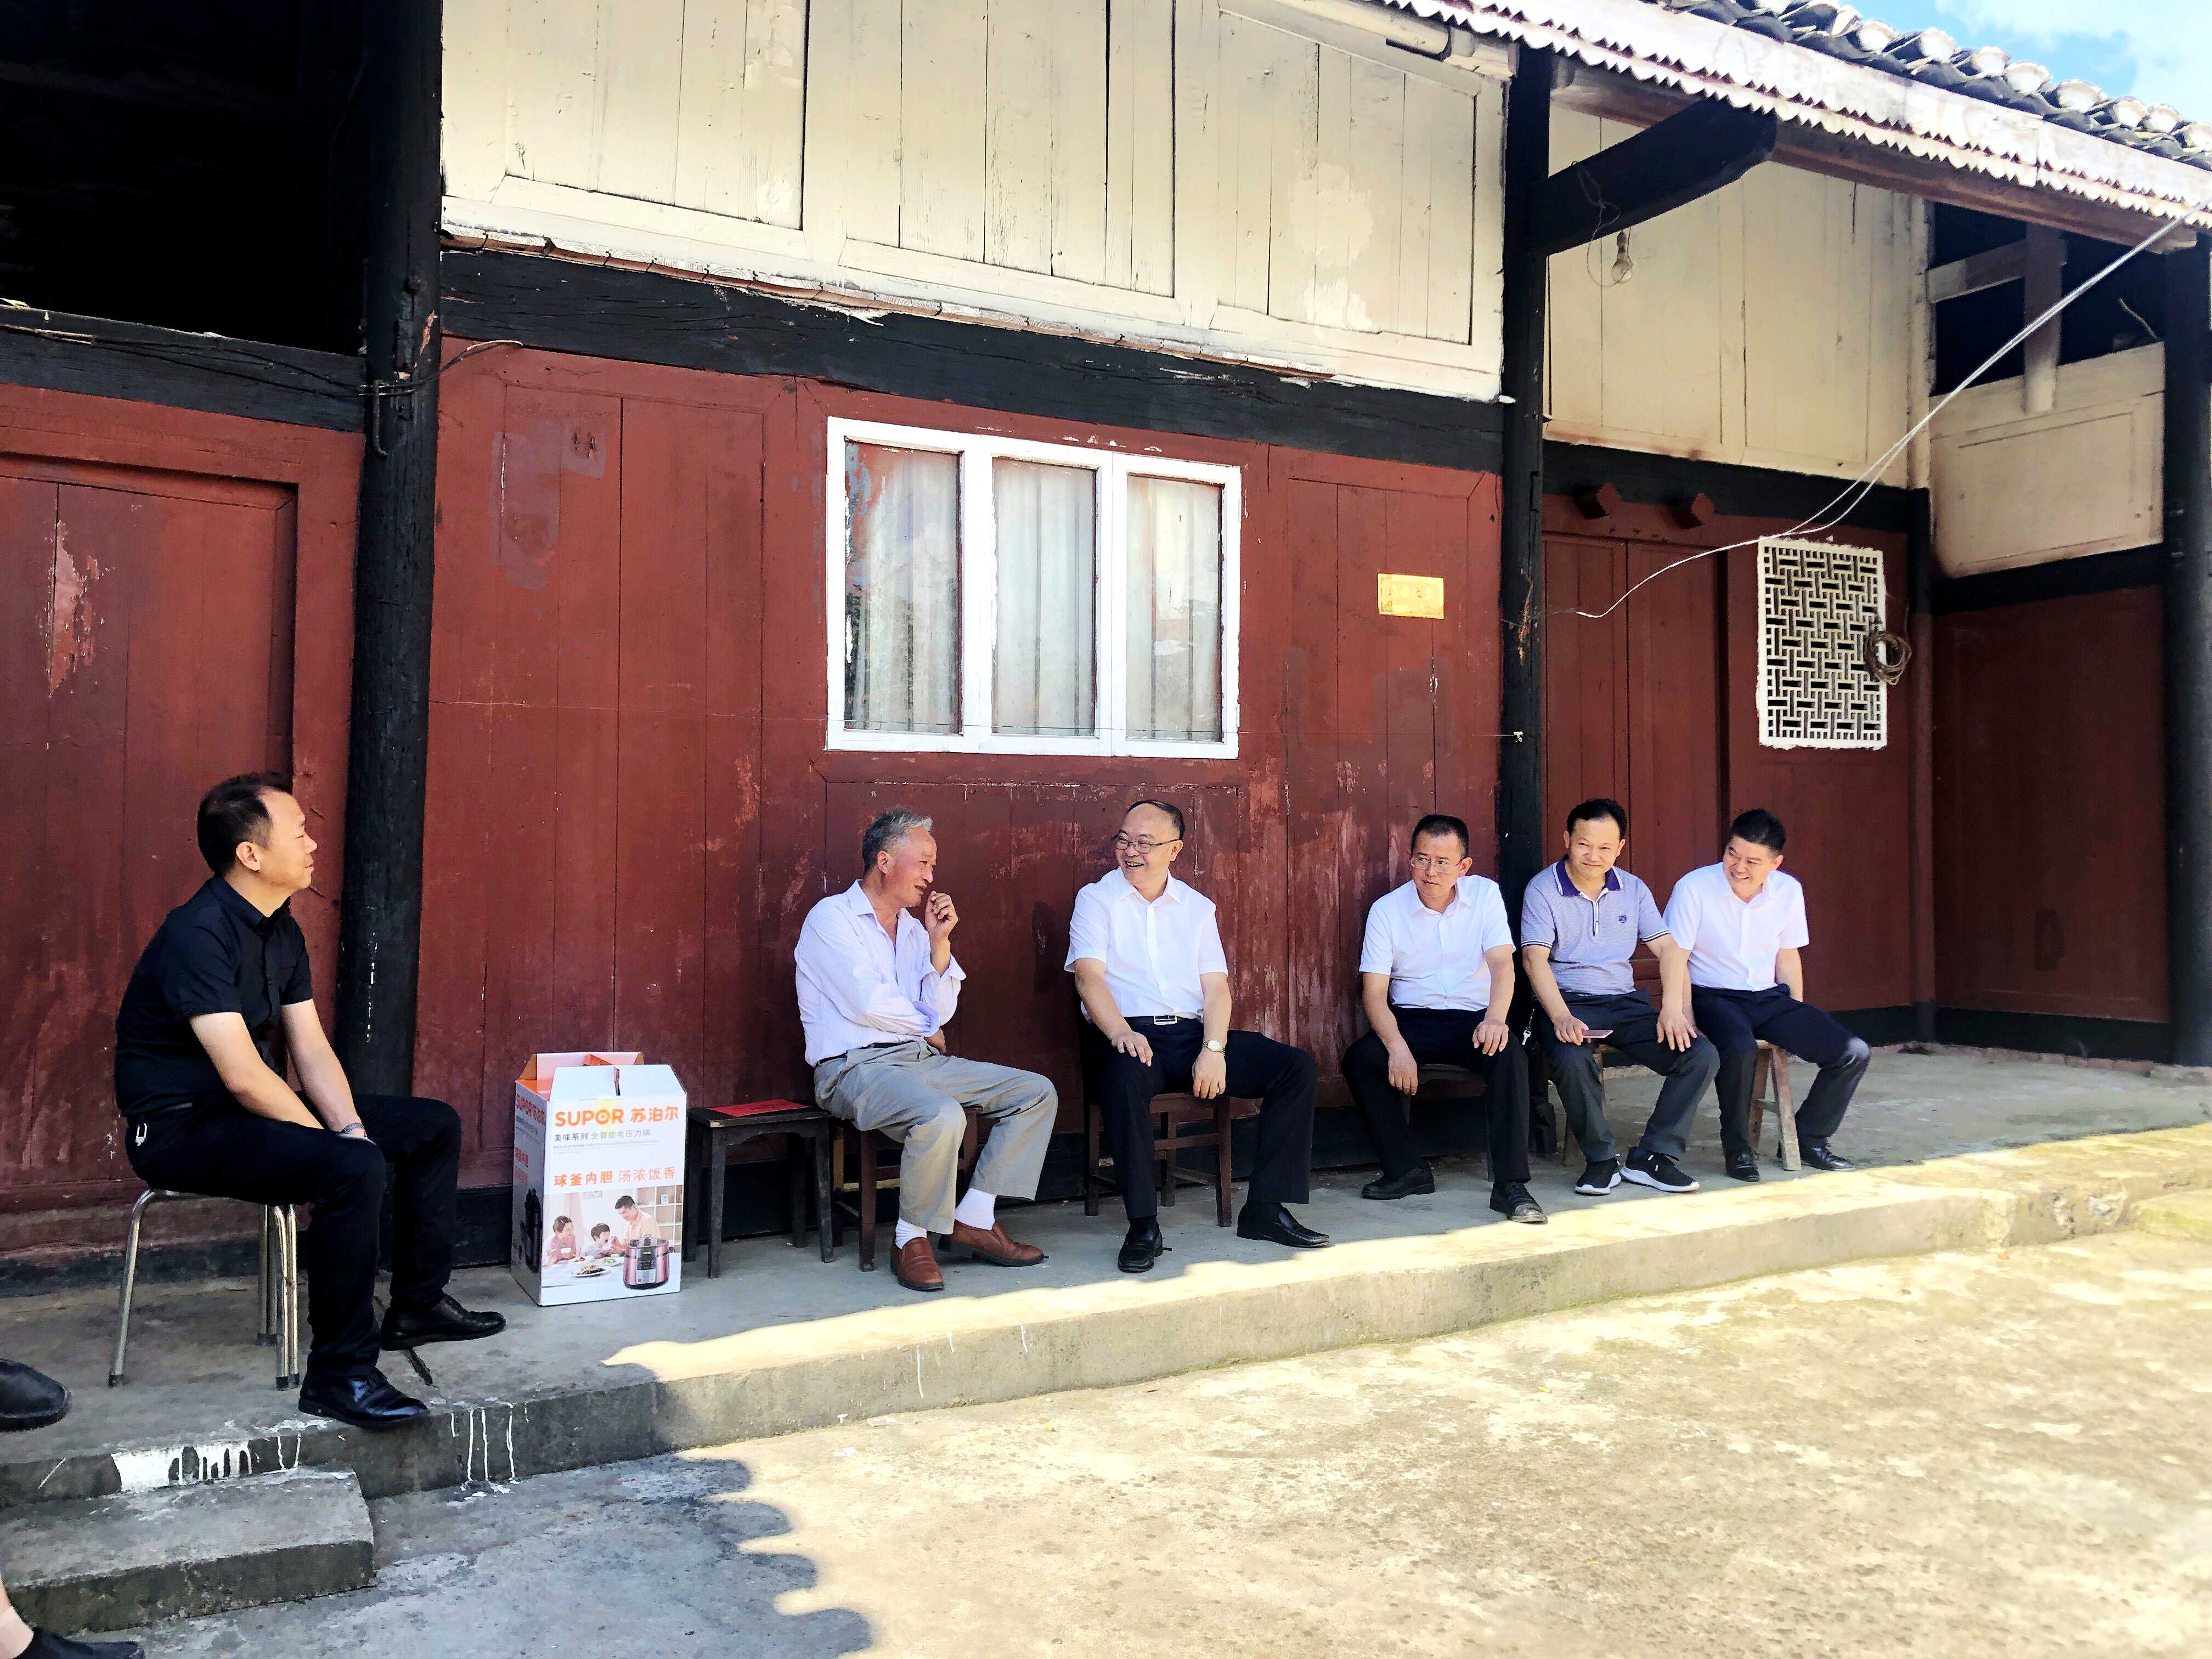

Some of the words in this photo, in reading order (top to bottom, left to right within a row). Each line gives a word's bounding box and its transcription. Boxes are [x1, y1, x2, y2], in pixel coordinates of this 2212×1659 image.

[554, 1109, 624, 1127] SUPOR
[630, 1106, 679, 1123] 苏泊尔
[554, 1132, 589, 1142] 美味系列
[591, 1129, 651, 1141] 全智能电压力锅
[554, 1171, 613, 1187] 球釜内胆
[618, 1166, 676, 1182] 汤浓饭香
